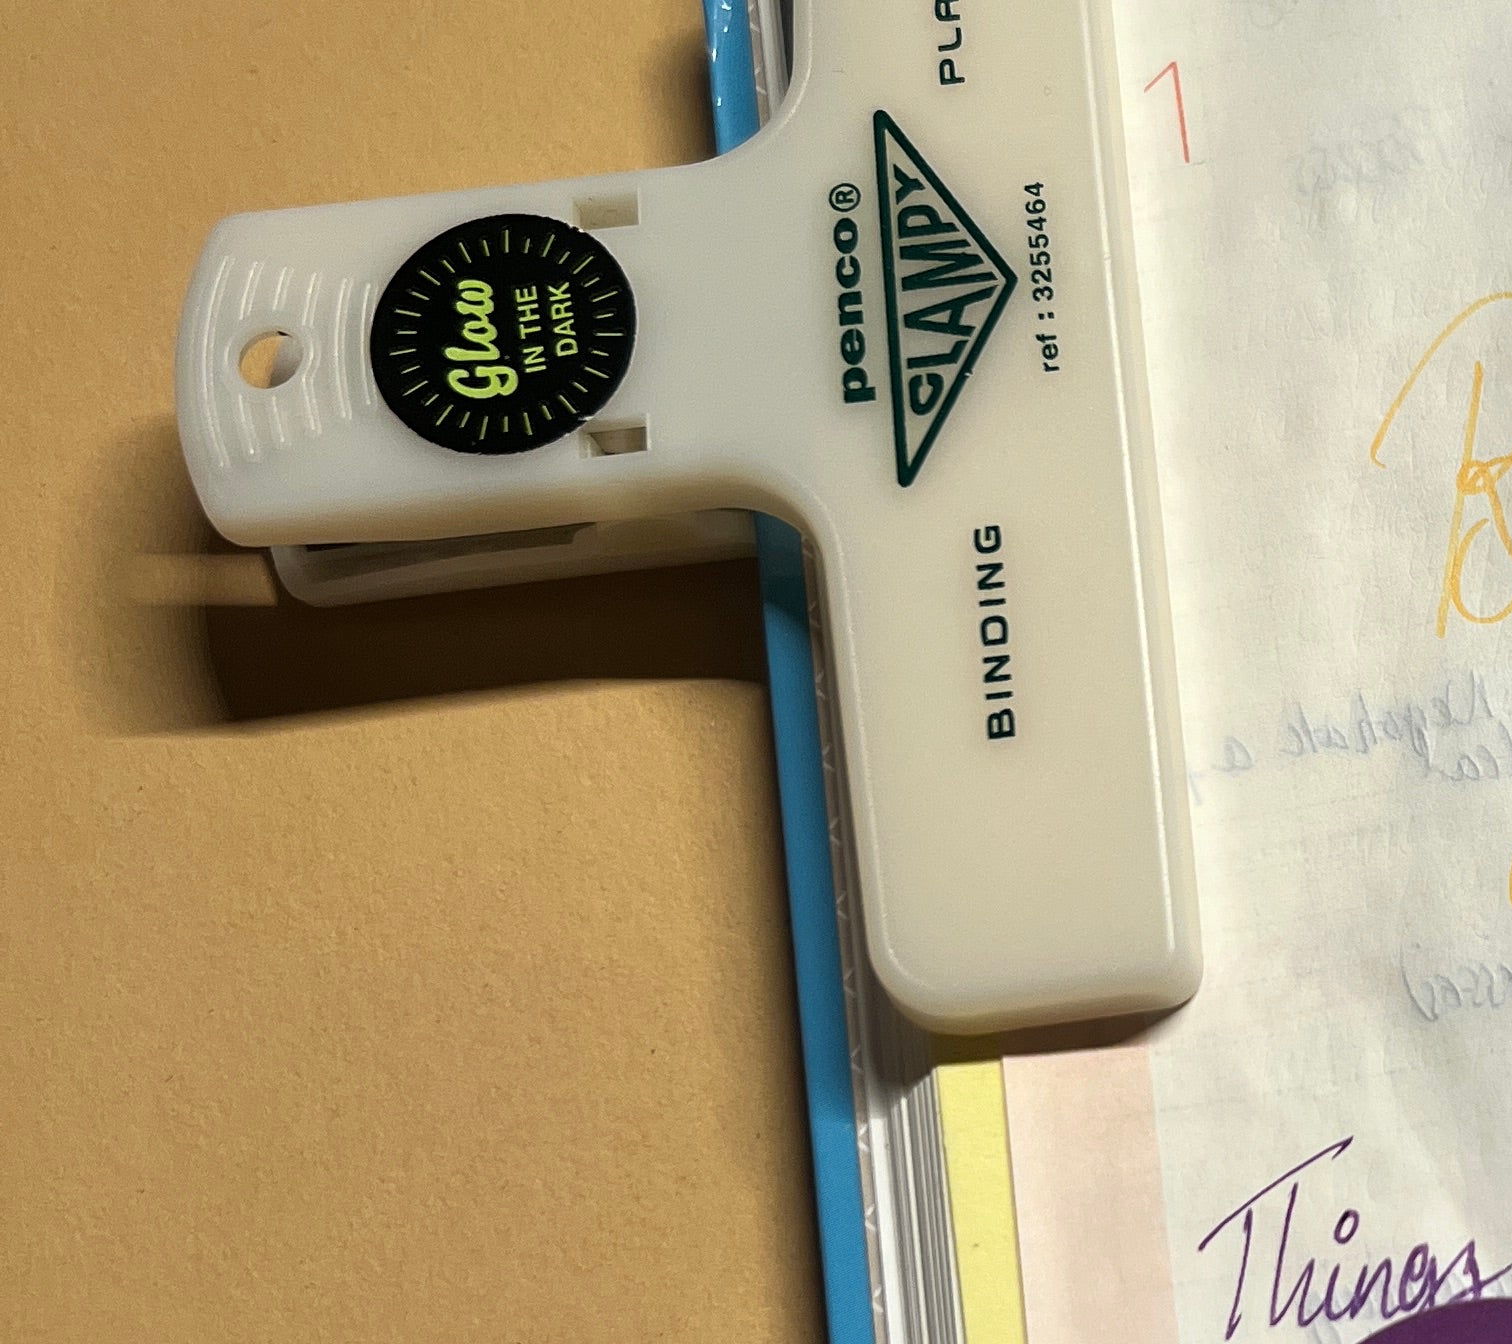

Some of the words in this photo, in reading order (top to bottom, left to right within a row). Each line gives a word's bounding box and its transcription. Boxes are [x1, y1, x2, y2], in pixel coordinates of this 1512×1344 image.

[1143, 61, 1190, 163] 1
[1024, 182, 1054, 302] 3255464
[515, 286, 542, 339] THE
[548, 282, 579, 356] DARK
[893, 163, 1000, 416] CLAMPY
[523, 346, 547, 373] IN
[1036, 333, 1060, 372] ref
[973, 525, 1016, 740] BINDING
